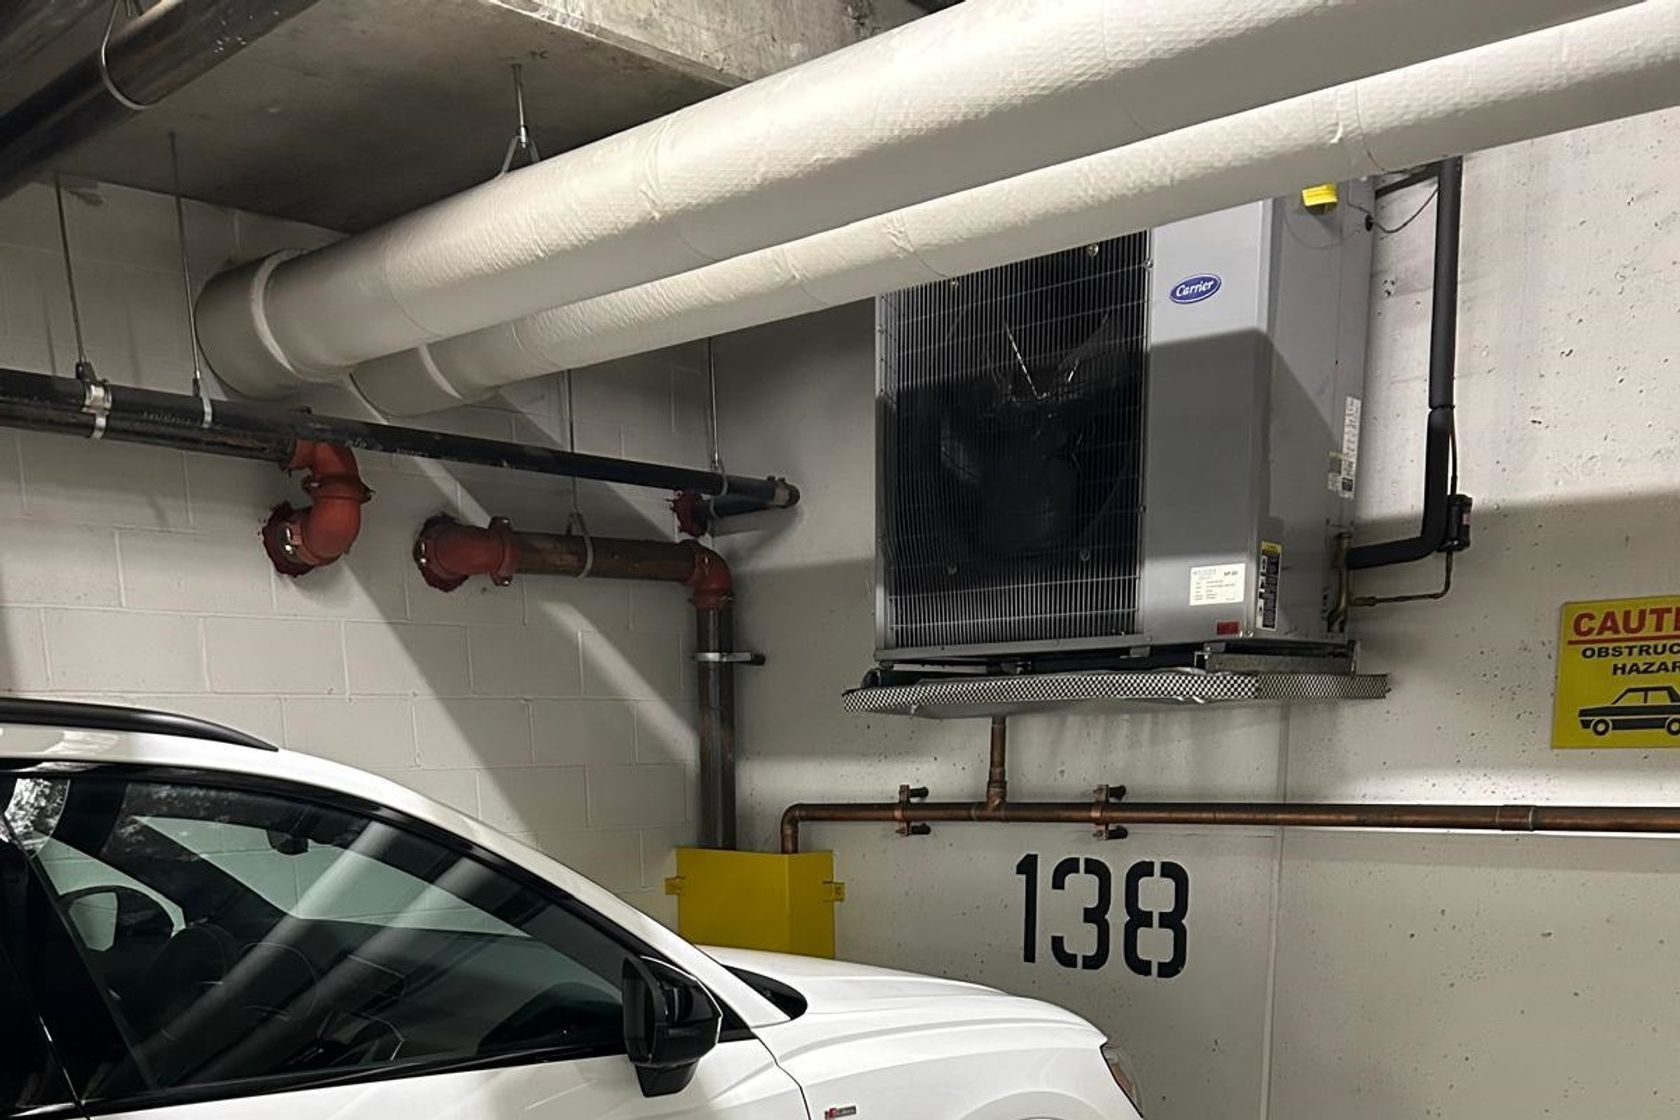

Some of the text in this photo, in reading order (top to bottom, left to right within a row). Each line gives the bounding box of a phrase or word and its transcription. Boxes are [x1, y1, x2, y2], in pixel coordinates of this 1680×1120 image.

[1176, 280, 1214, 297] Carrier
[1582, 643, 1680, 659] OBSTRUC
[1016, 853, 1189, 978] 138
